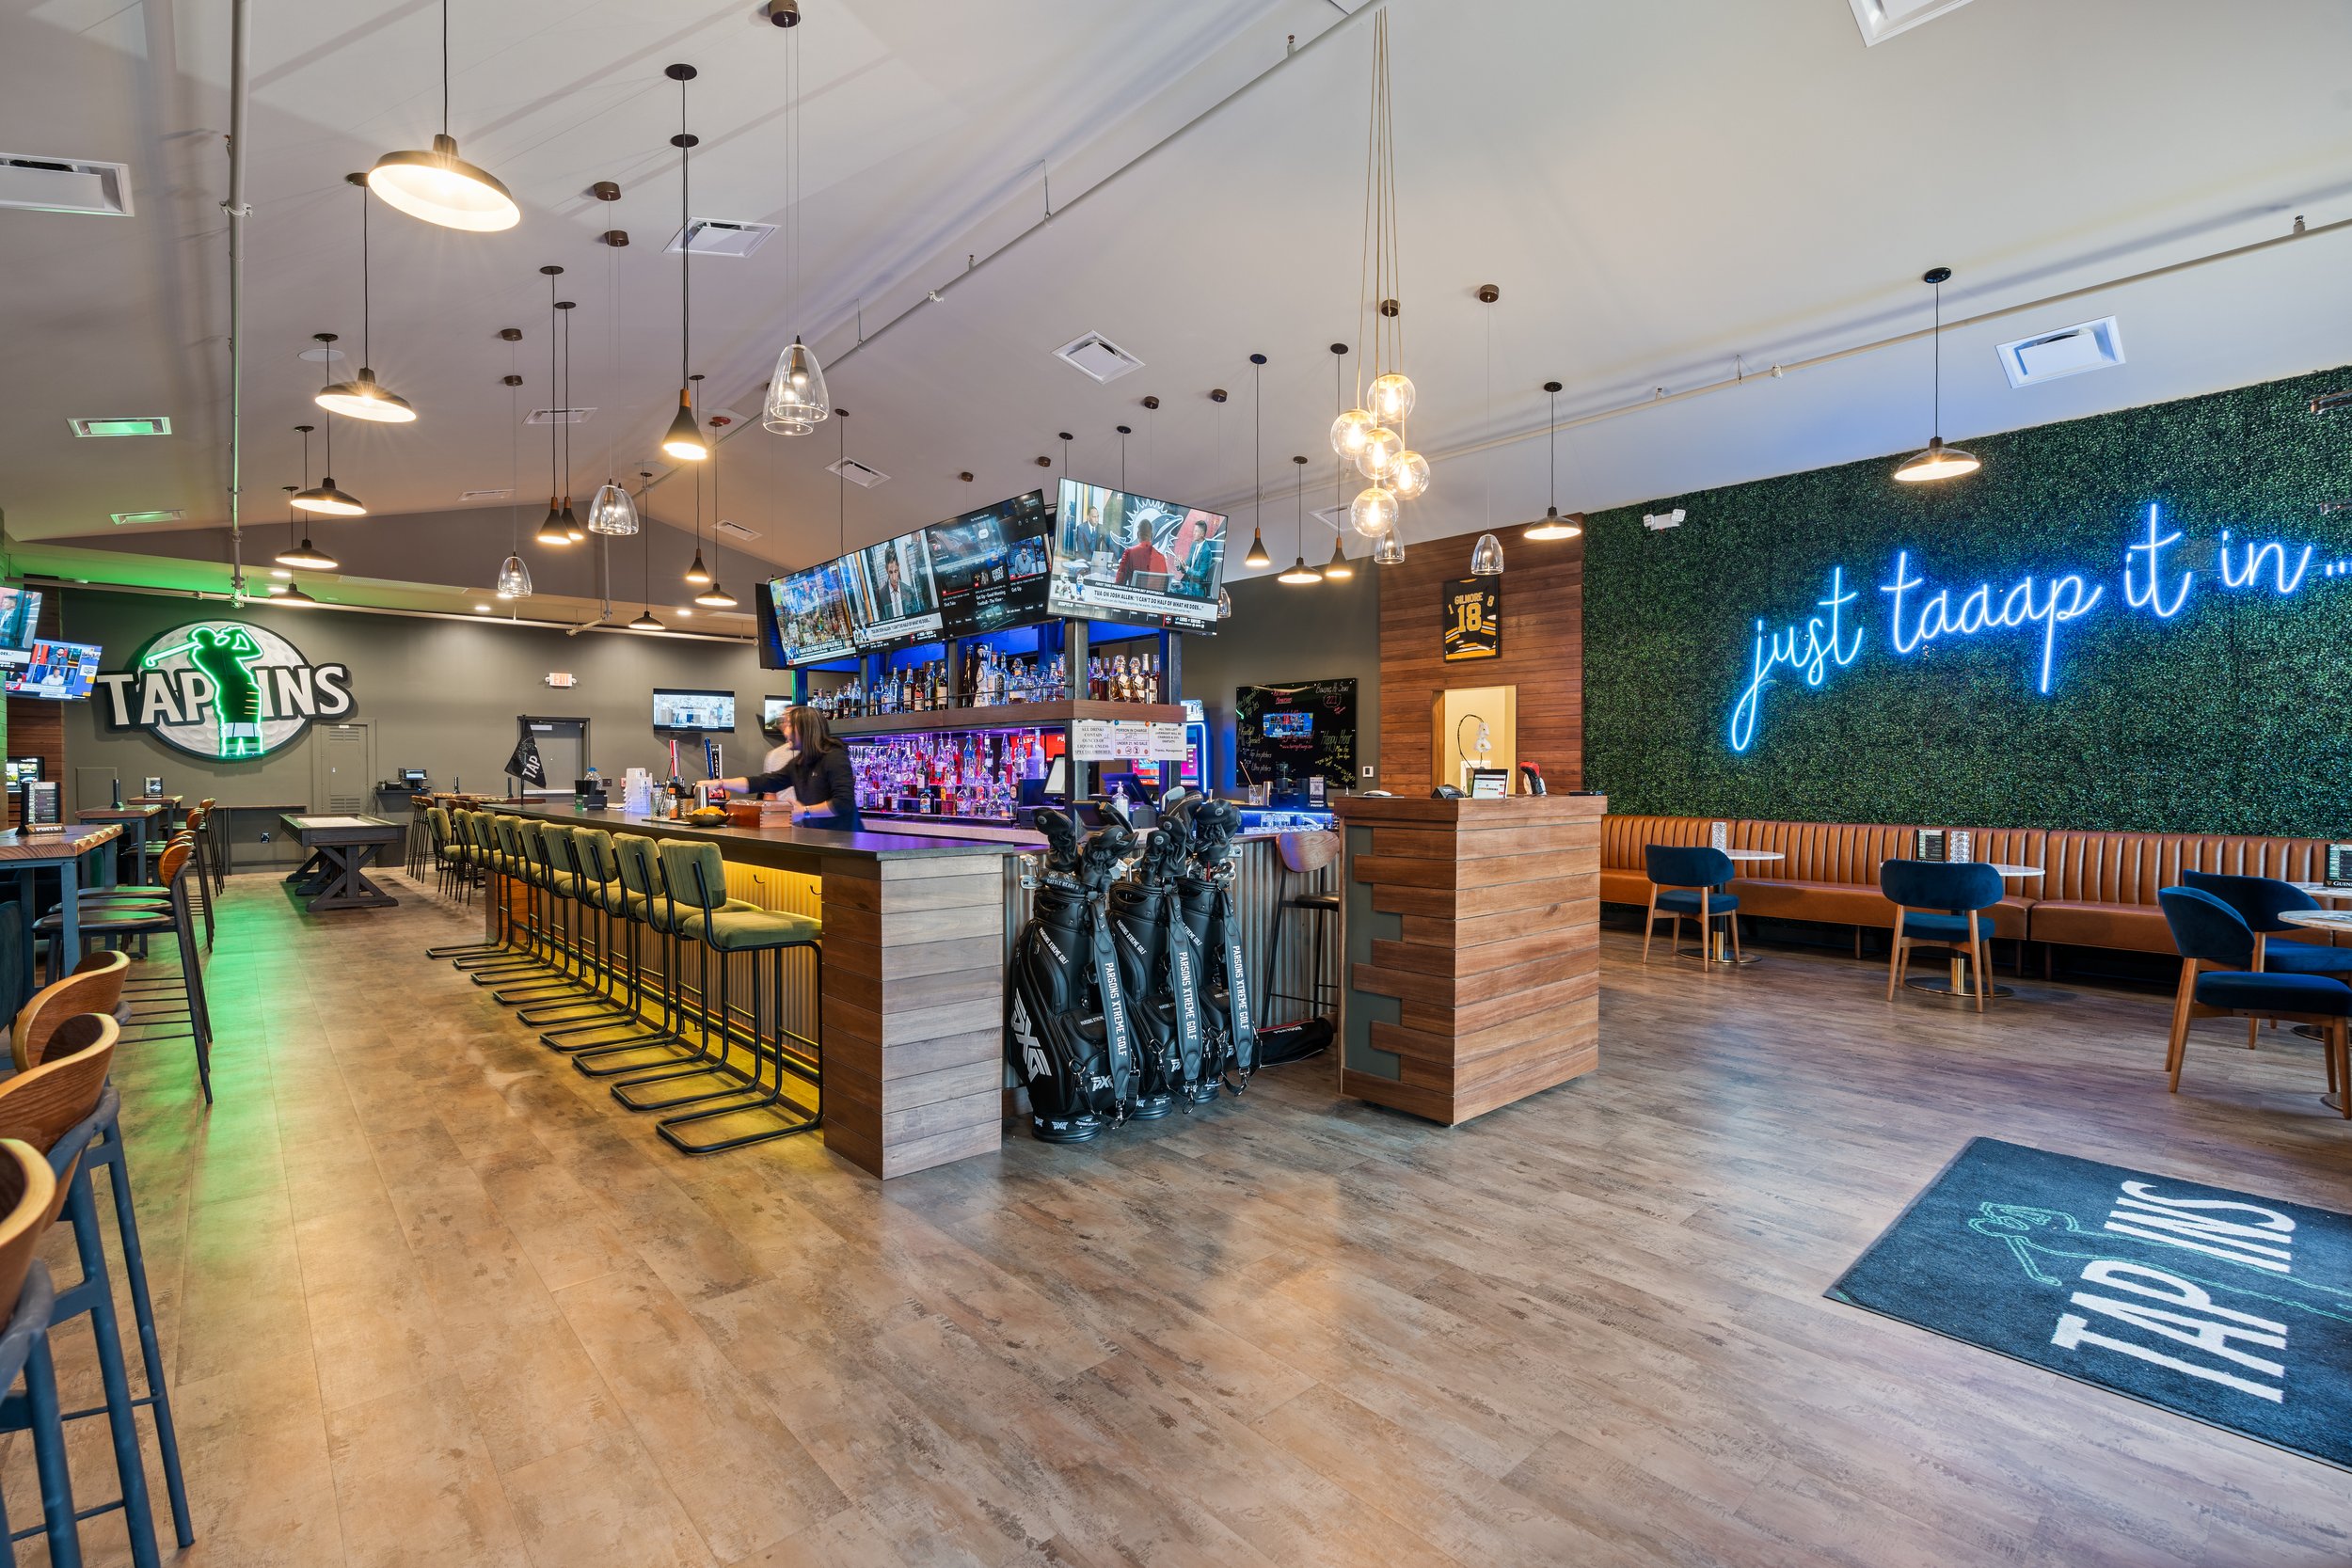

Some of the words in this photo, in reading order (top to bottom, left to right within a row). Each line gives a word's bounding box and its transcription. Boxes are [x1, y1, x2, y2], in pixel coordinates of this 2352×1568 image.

[1454, 592, 1484, 605] GILMORE
[1457, 602, 1482, 633] 18
[1732, 566, 1863, 752] just
[1880, 551, 2103, 694] taaap
[2124, 503, 2192, 619] it
[2221, 531, 2352, 594] in..
[96, 672, 215, 725] TAP
[255, 666, 350, 718] INS
[522, 755, 541, 778] TAP
[1039, 927, 1050, 944] PARSONS
[1047, 941, 1061, 957] XTREME
[1057, 954, 1070, 965] GOLF
[1117, 919, 1128, 937] PARSONS
[1126, 933, 1139, 949] XTREME
[1136, 943, 1148, 956] GOLF
[1193, 937, 1203, 946] GOLF
[1179, 951, 1190, 987] PARSONS
[1232, 945, 1244, 979] PARSONS
[1104, 962, 1119, 999] PARSONS
[1236, 979, 1248, 1011] XTREME
[1112, 1001, 1125, 1035] XTREME
[1183, 988, 1195, 1021] XTREME
[1239, 1012, 1249, 1030] GOLF
[1010, 988, 1053, 1083] PXG
[1117, 1037, 1127, 1056] GOLF
[1186, 1022, 1197, 1040] GOLF
[2104, 1180, 2297, 1274] INS
[2050, 1259, 2288, 1403] TAP
